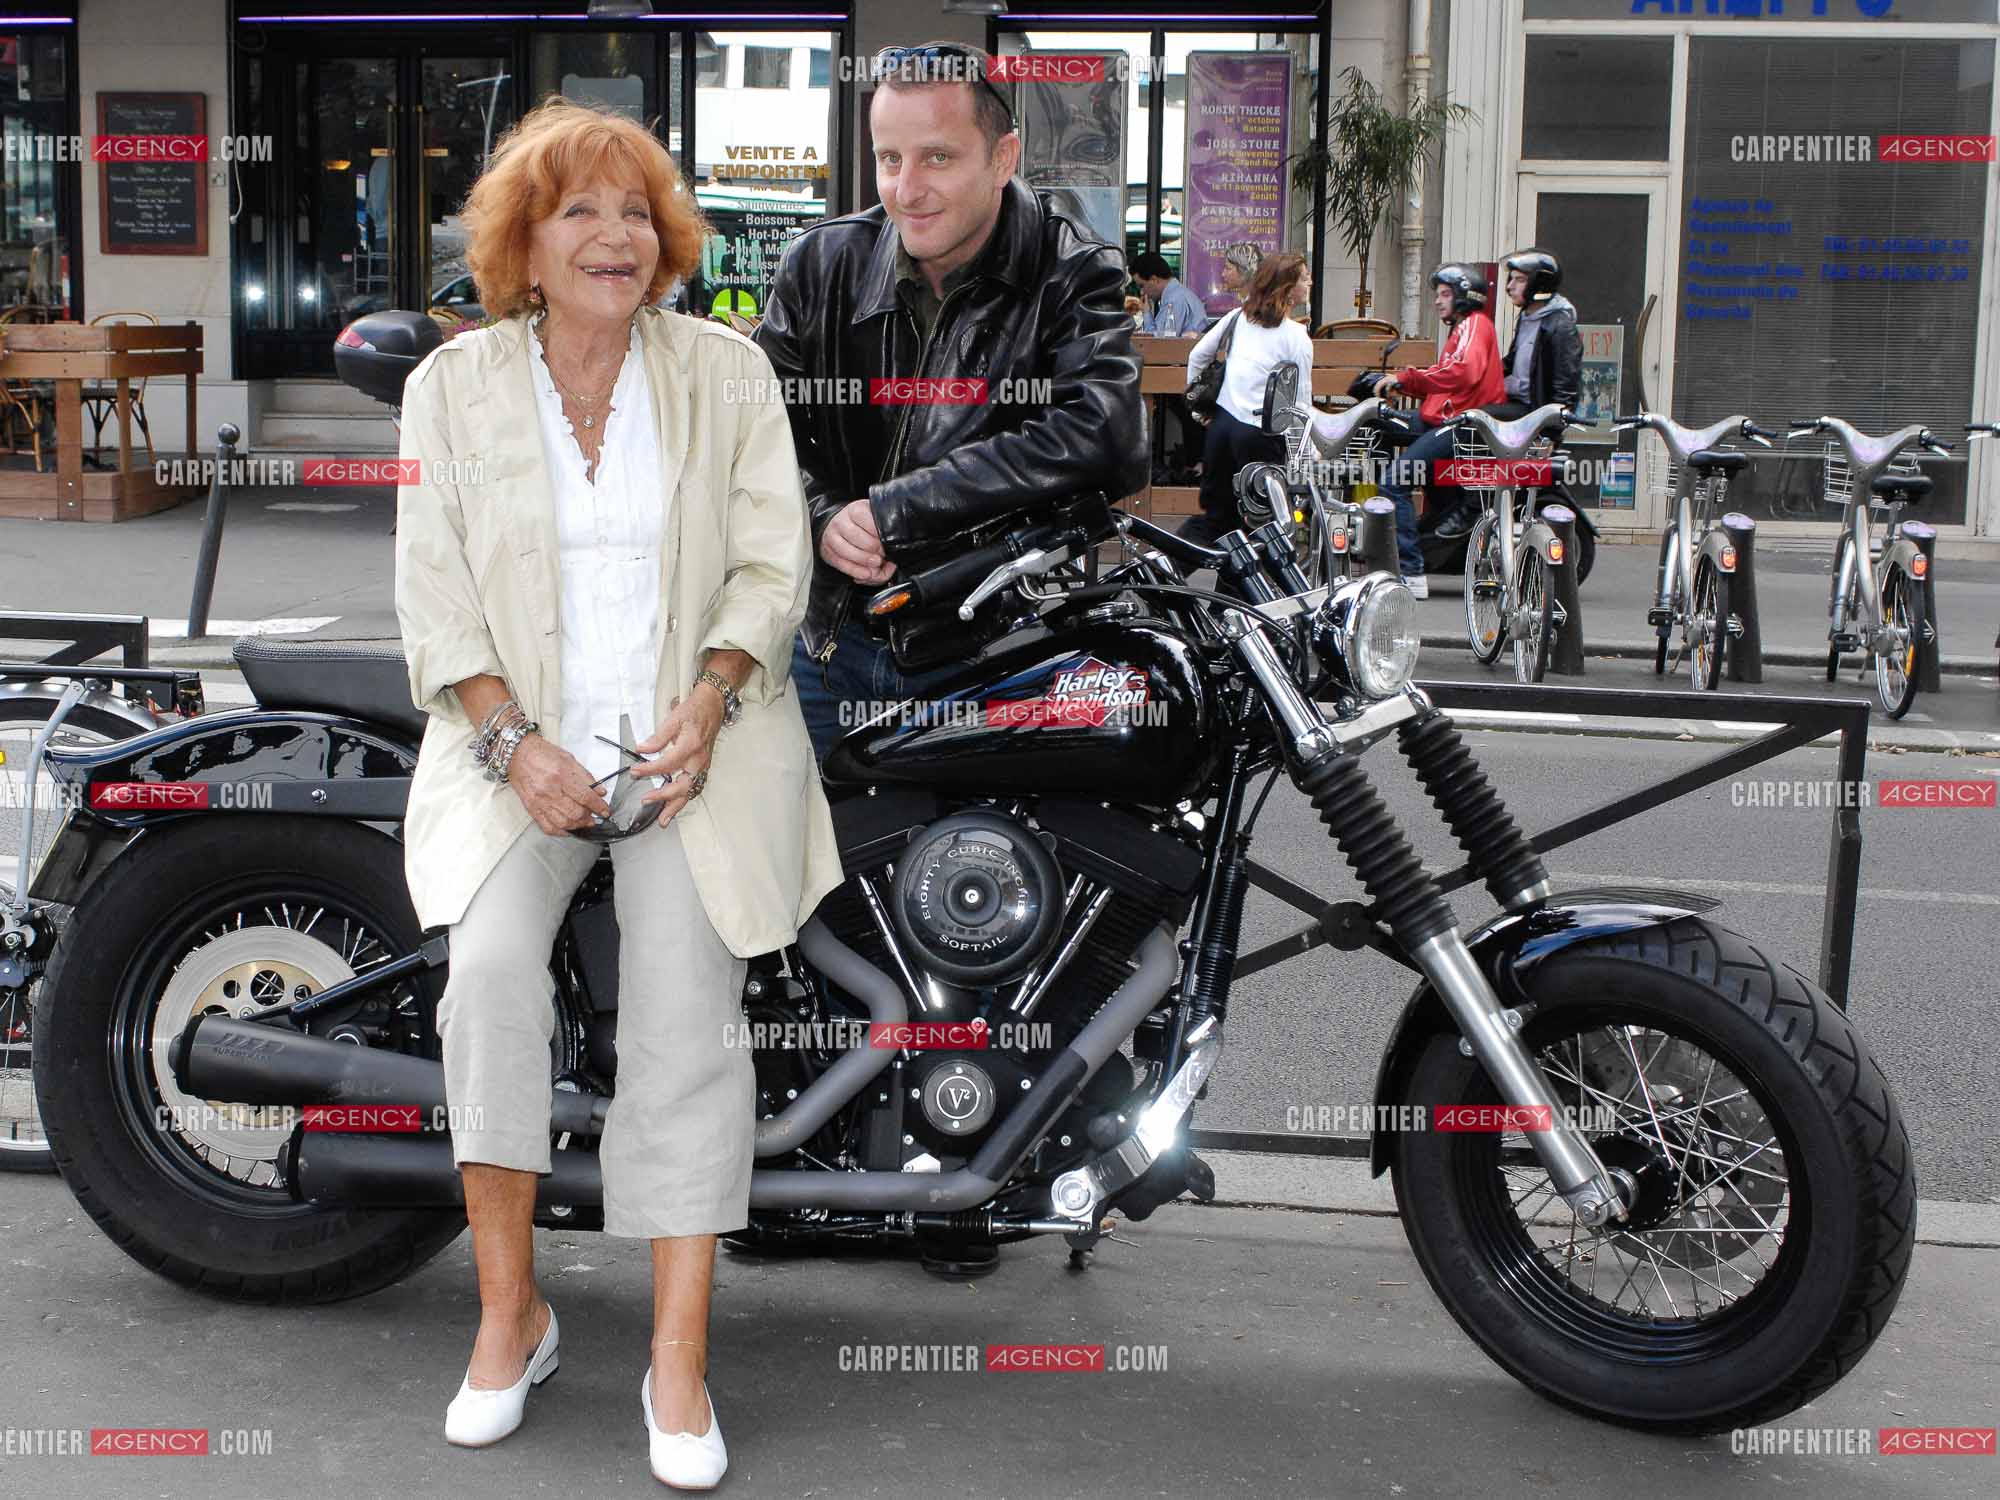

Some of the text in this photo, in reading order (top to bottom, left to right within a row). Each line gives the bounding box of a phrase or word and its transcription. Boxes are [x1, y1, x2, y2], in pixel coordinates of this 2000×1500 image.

[1200, 104, 1281, 117] ROBIN THICKE
[1241, 139, 1280, 150] STONE
[725, 145, 818, 160] VENTE A
[712, 164, 832, 179] EMPORTER
[1221, 172, 1278, 184] RIHANNA
[1246, 207, 1278, 217] WEST
[745, 213, 797, 226] Boissons
[1052, 688, 1147, 712] Davidson
[920, 859, 942, 921] EIGHTY
[947, 845, 1001, 859] CUBIC
[938, 933, 1009, 952] SOFTAIL
